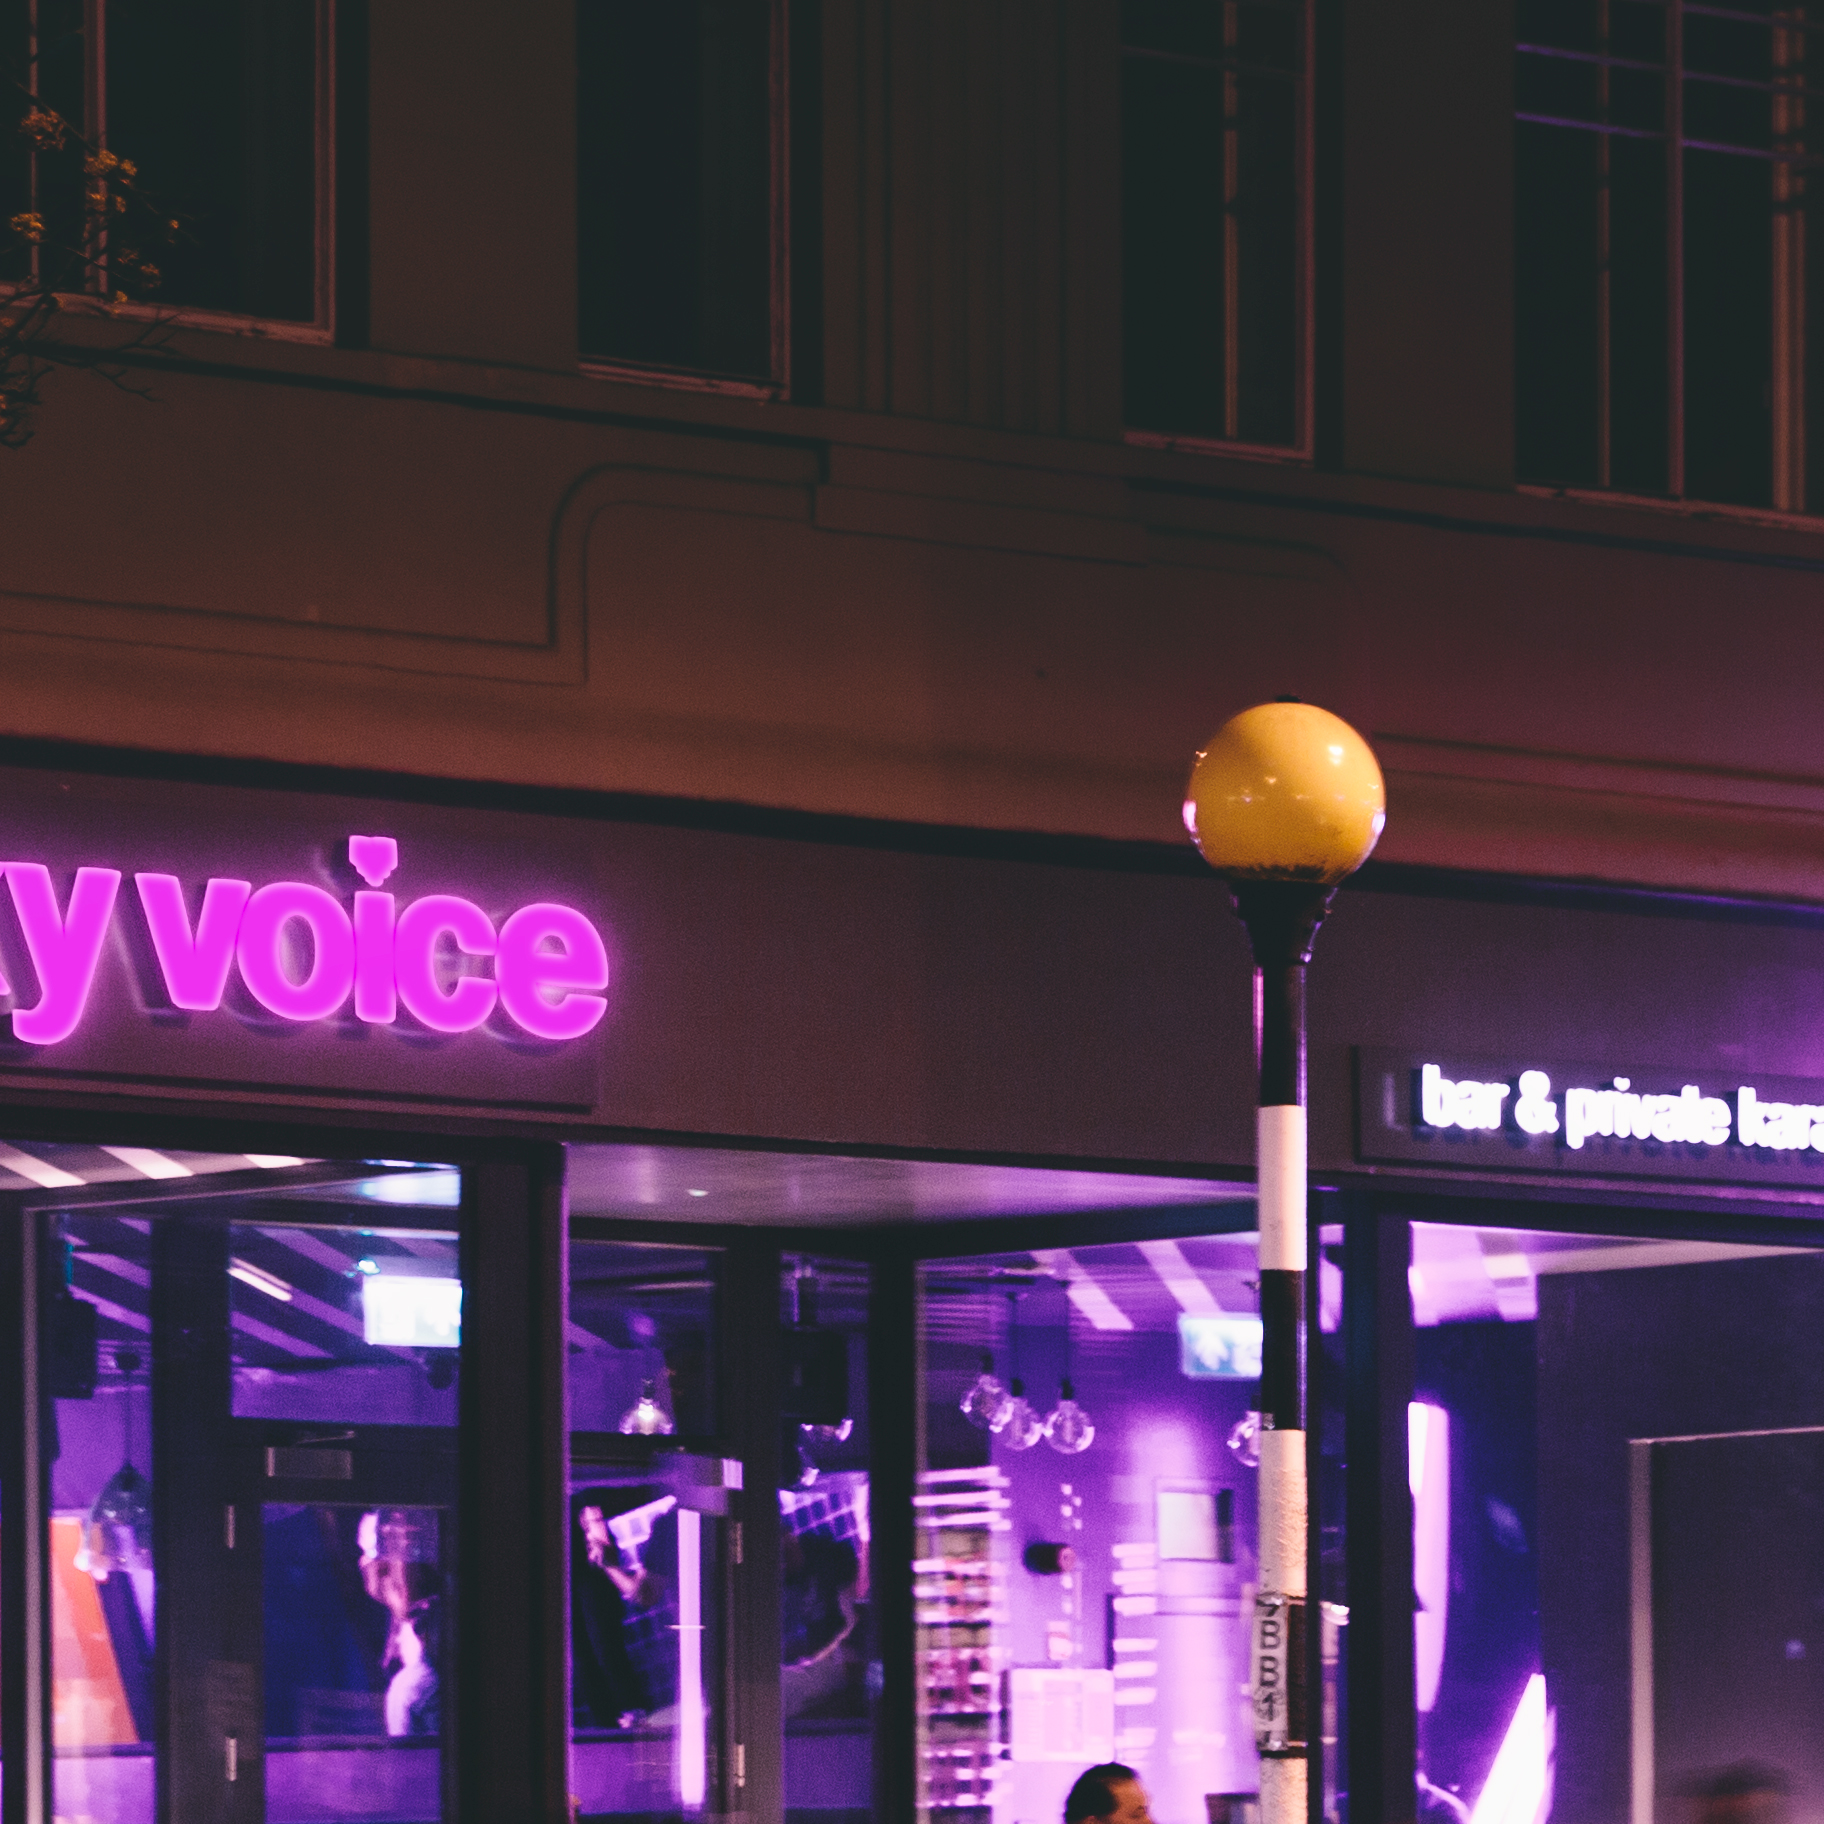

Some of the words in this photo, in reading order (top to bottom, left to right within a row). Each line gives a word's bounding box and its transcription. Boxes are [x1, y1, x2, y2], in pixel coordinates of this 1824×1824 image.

[133, 834, 609, 1041] voice
[1421, 1063, 1508, 1130] bar
[1515, 1070, 1559, 1134] &
[1565, 1077, 1731, 1150] private
